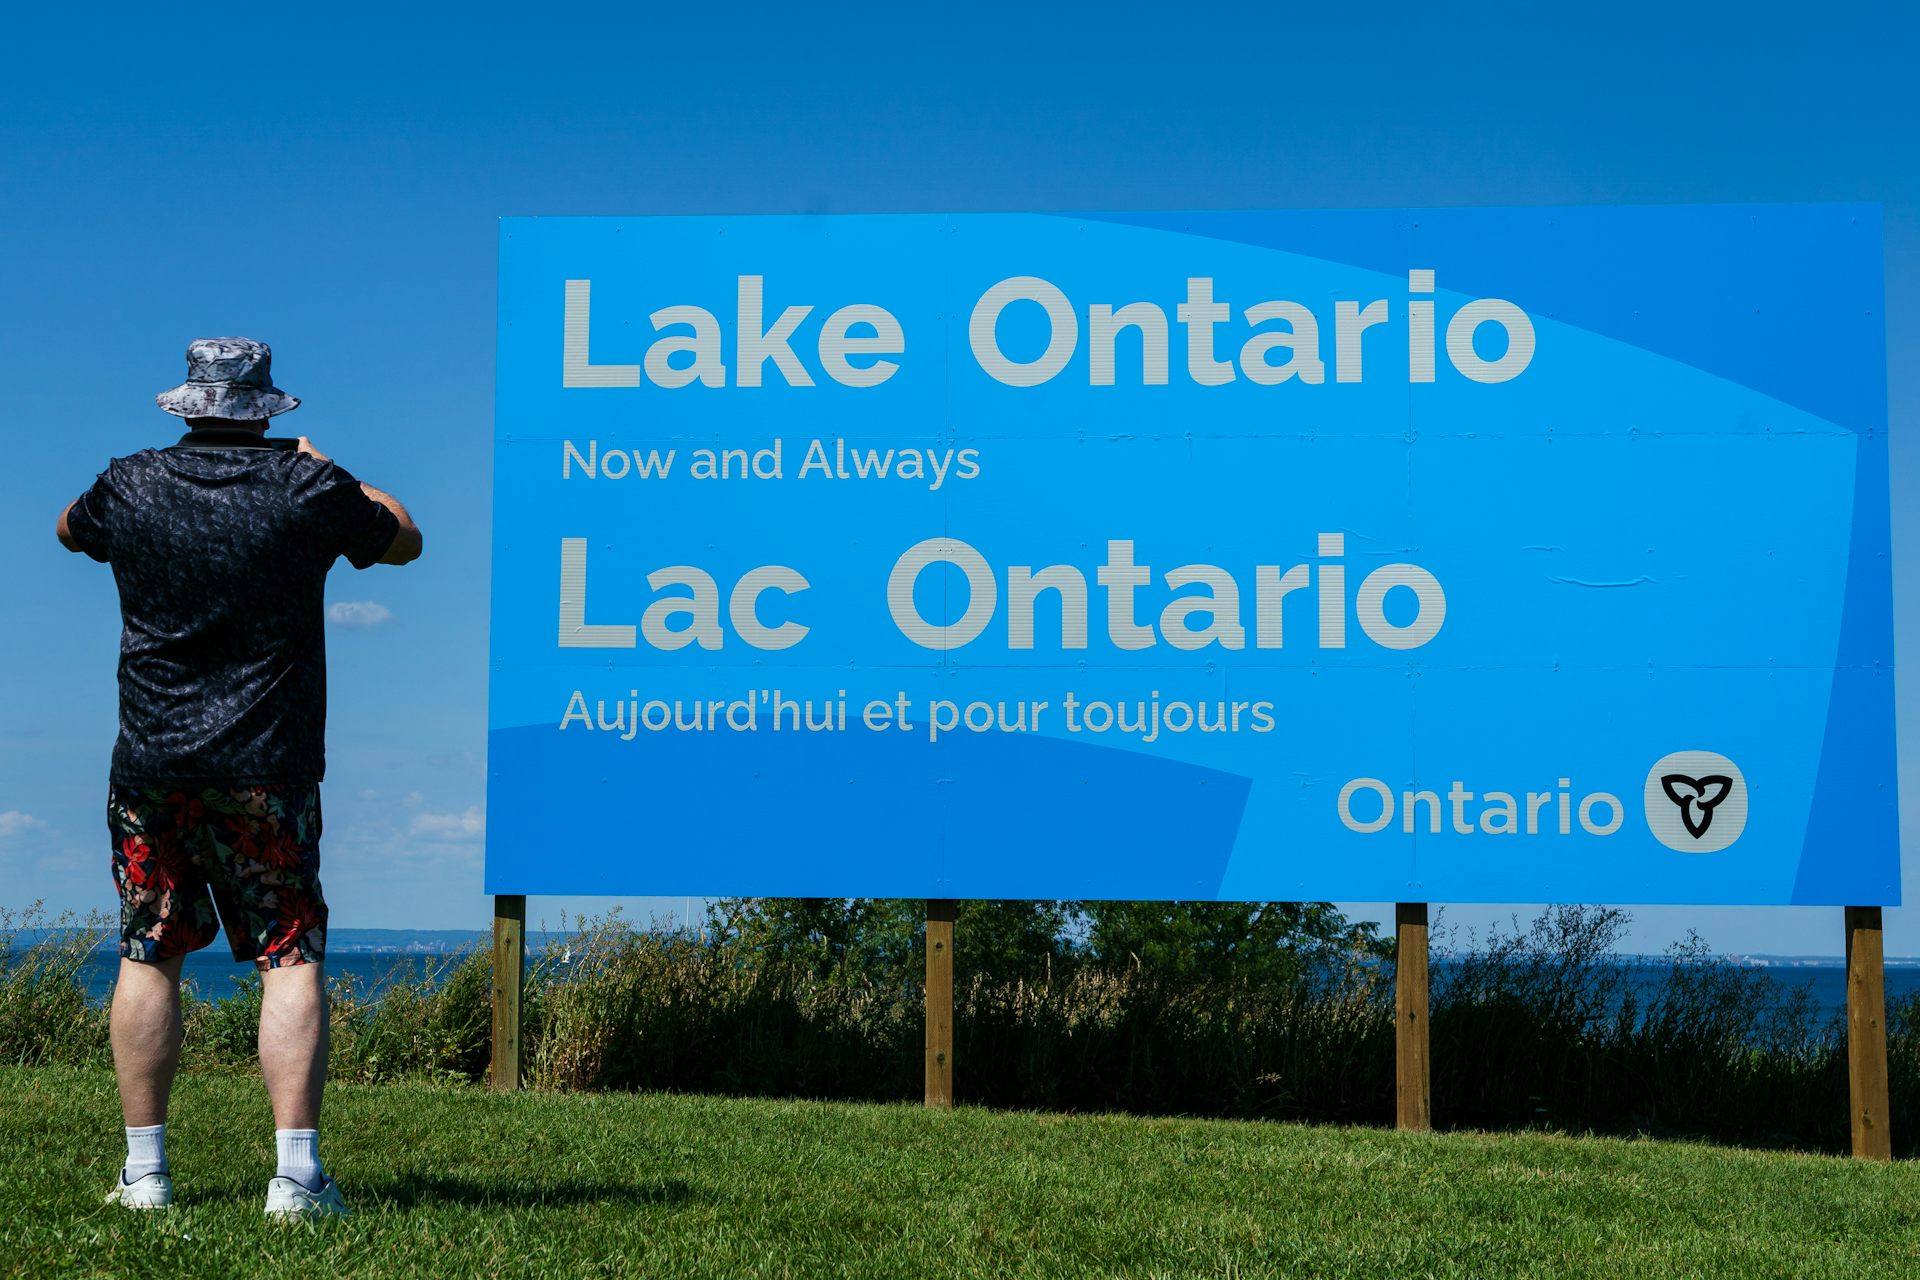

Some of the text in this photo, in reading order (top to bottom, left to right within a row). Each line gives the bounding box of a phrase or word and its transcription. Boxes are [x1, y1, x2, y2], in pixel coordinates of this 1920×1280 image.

[563, 269, 1537, 388] Lake Ontario
[562, 438, 982, 491] Now and Always
[558, 532, 1447, 651] Lac Ontario
[863, 691, 913, 731] et
[930, 700, 1049, 743] pour
[1064, 690, 1276, 743] toujours
[1337, 777, 1625, 836] Ontario
